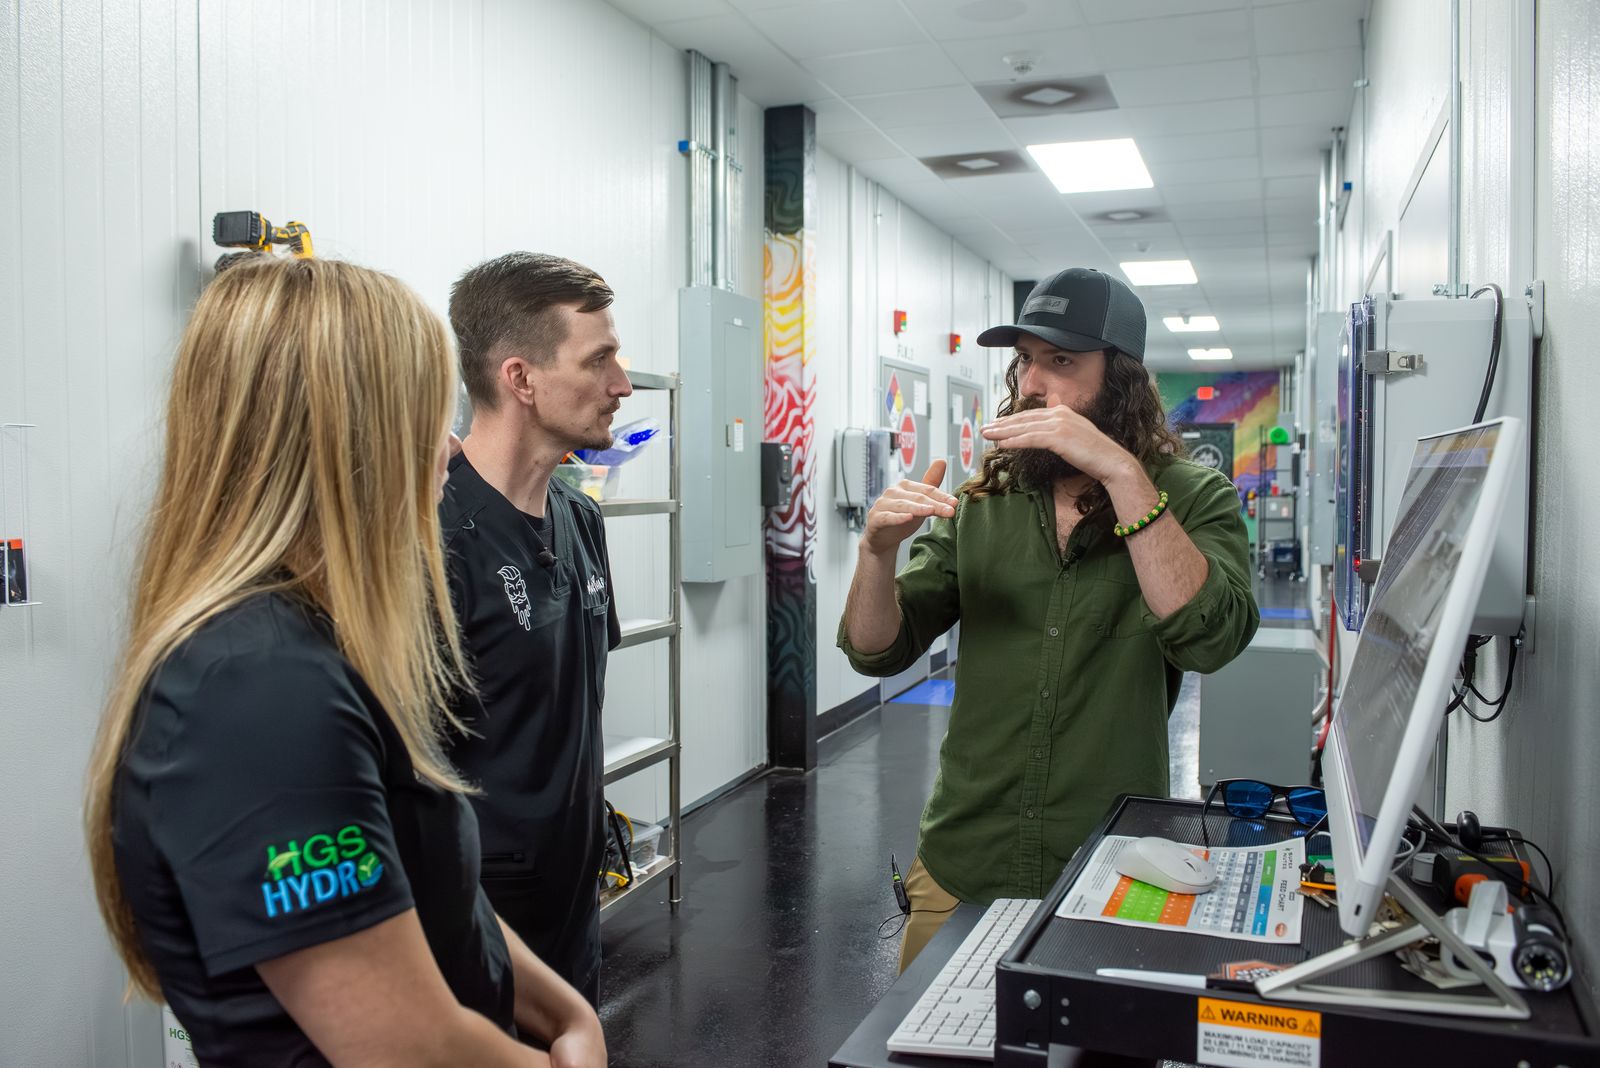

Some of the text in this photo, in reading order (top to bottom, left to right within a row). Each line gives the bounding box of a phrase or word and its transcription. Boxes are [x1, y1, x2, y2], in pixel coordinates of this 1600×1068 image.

[901, 432, 915, 448] STOP
[266, 824, 368, 881] HGS
[261, 851, 384, 918] HYDRO
[1279, 879, 1289, 893] FEED
[1276, 893, 1287, 912] CHART
[1220, 1008, 1298, 1030] WARNING
[169, 1027, 192, 1042] HGS
[1204, 1031, 1312, 1050] MAXIMUM LOAD CAPACITY
[1216, 1048, 1256, 1059] CLIMBING
[1272, 1056, 1312, 1067] HANGING
[1267, 1047, 1283, 1055] TOP
[1285, 1050, 1312, 1059] SHELF
